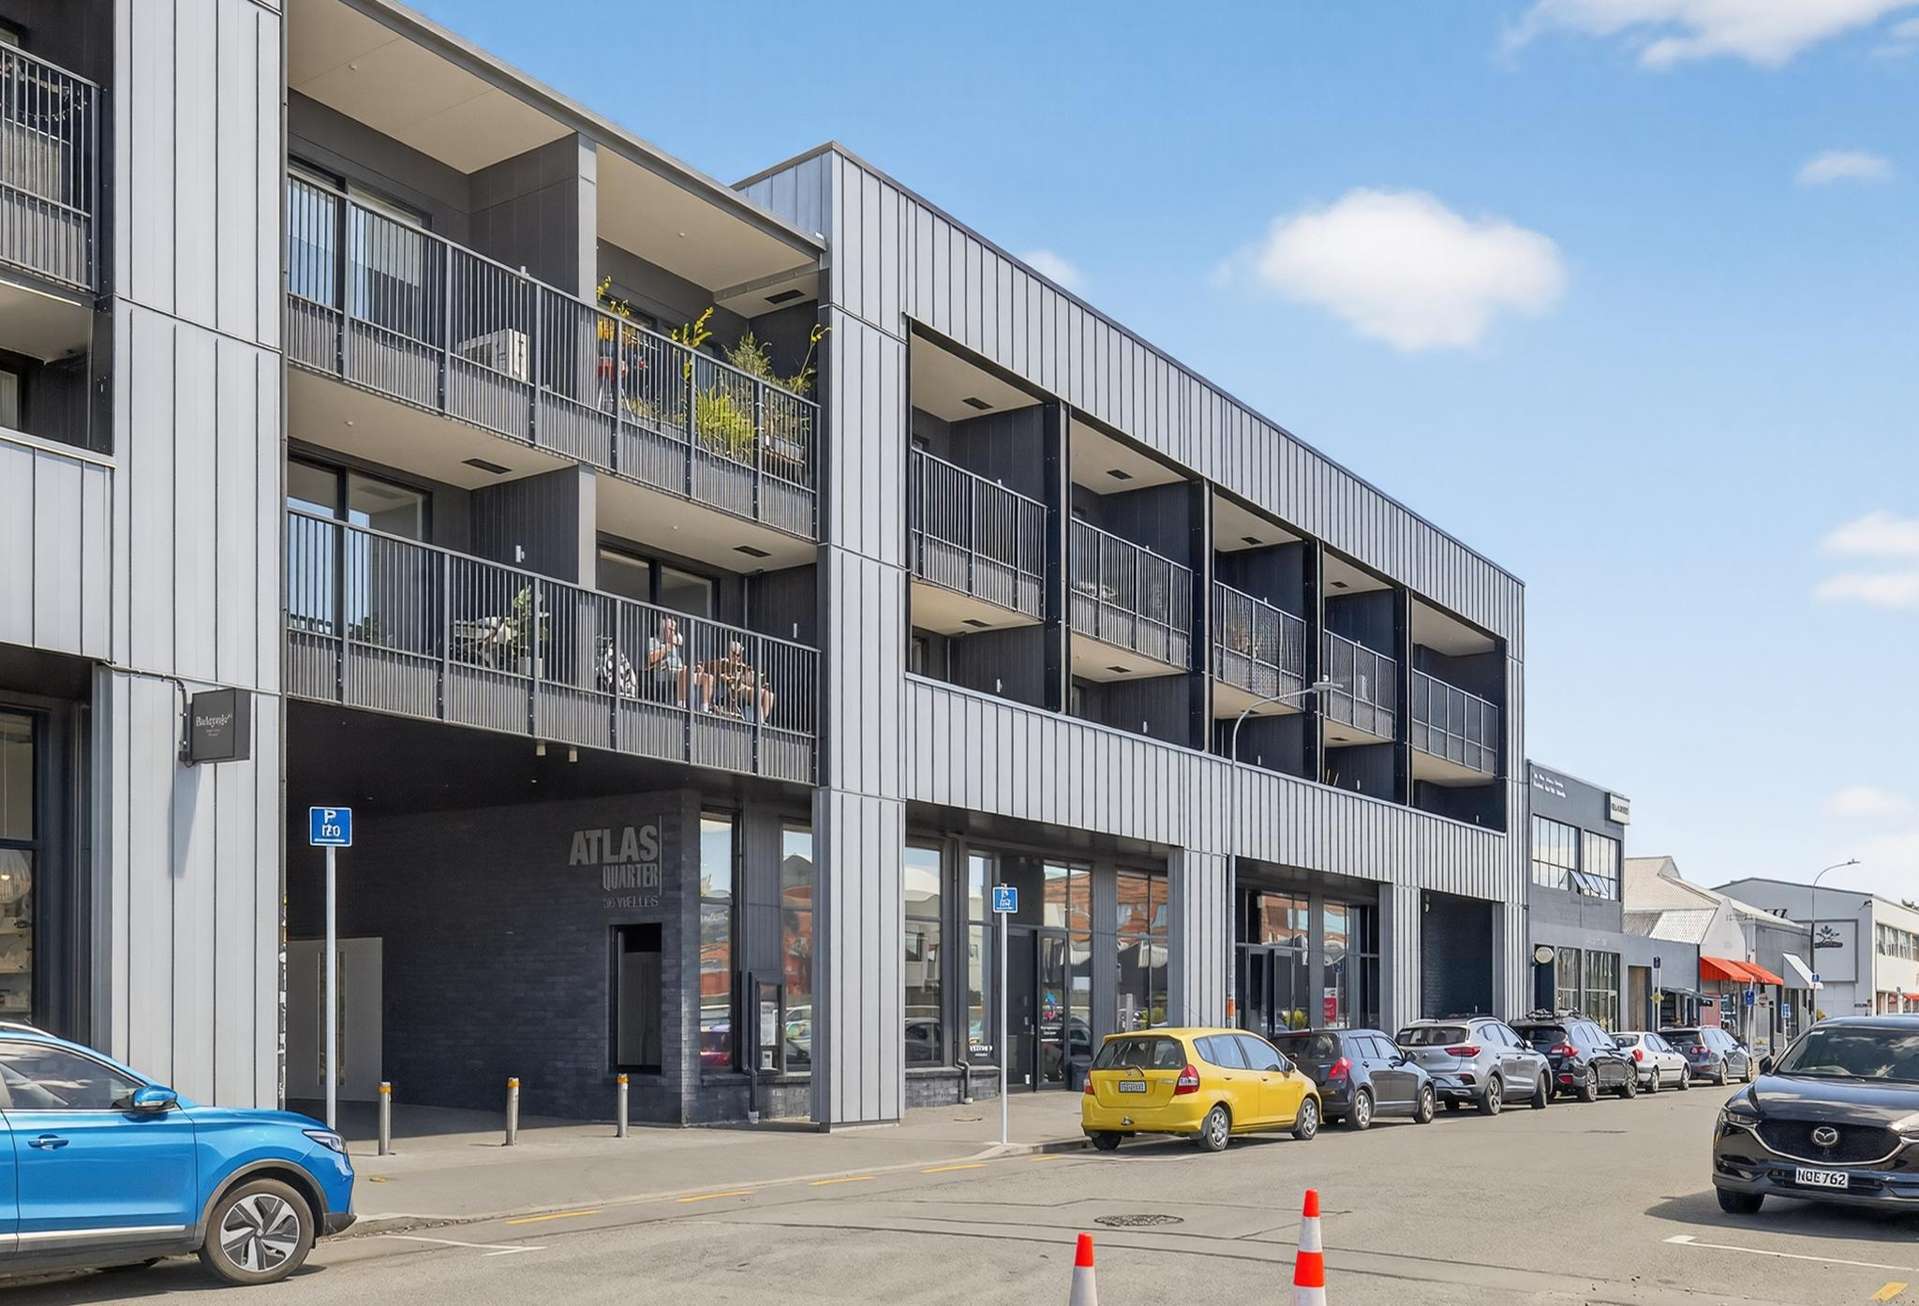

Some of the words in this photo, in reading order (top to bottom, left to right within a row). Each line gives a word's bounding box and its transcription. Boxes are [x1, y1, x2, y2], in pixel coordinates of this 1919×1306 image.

[324, 810, 337, 824] P
[322, 824, 341, 837] 120
[568, 824, 658, 866] ATLAS
[602, 863, 658, 891] QUARTER
